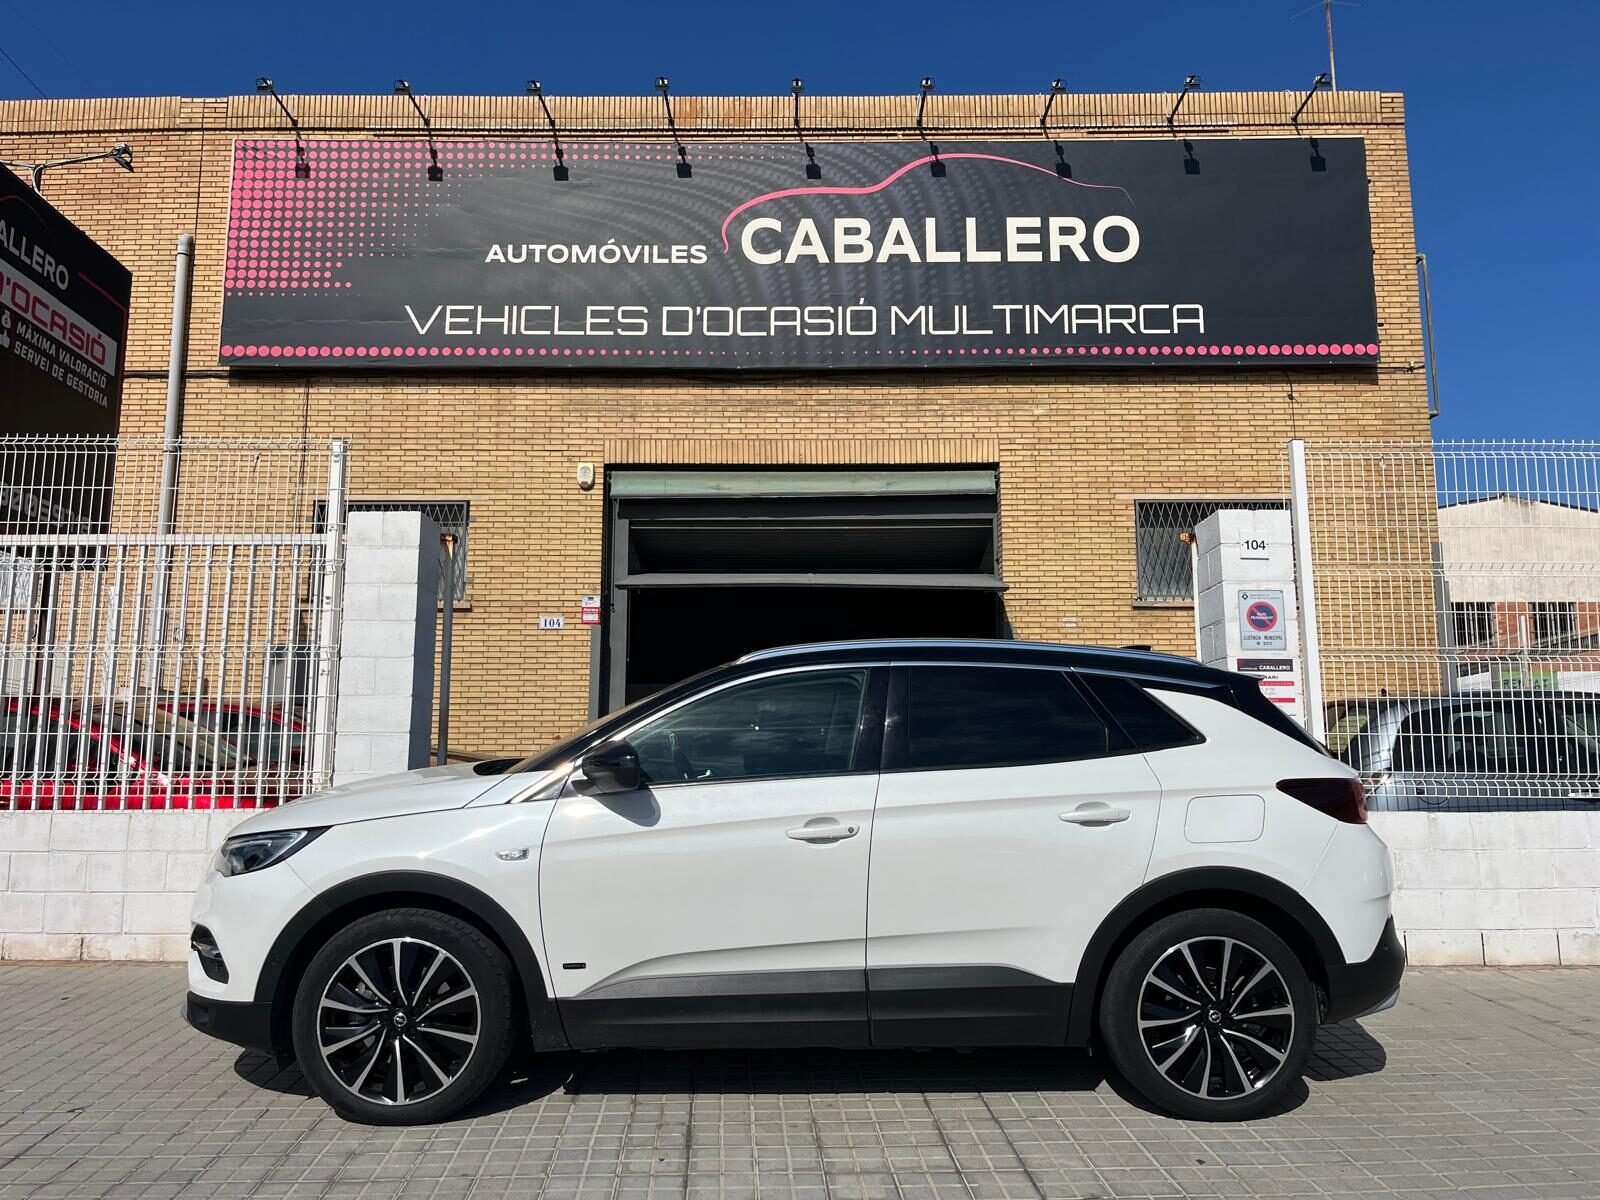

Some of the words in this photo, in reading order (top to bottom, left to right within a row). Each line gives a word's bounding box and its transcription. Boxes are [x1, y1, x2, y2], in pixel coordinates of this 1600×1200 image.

[484, 238, 708, 264] AUTOMÓVILES
[741, 215, 1140, 265] CABALLERO
[0, 271, 107, 366] 'OCASIÓ
[404, 304, 649, 336] VEHICLES
[661, 298, 877, 337] D'OCASIÓ
[890, 303, 1206, 336] MULTIMARCA
[14, 340, 51, 372] SERVEI
[51, 363, 65, 382] DE
[66, 372, 109, 409] GESTORIA
[59, 347, 108, 389] VALORACIÓ
[1243, 539, 1267, 551] 104
[543, 618, 562, 628] 104
